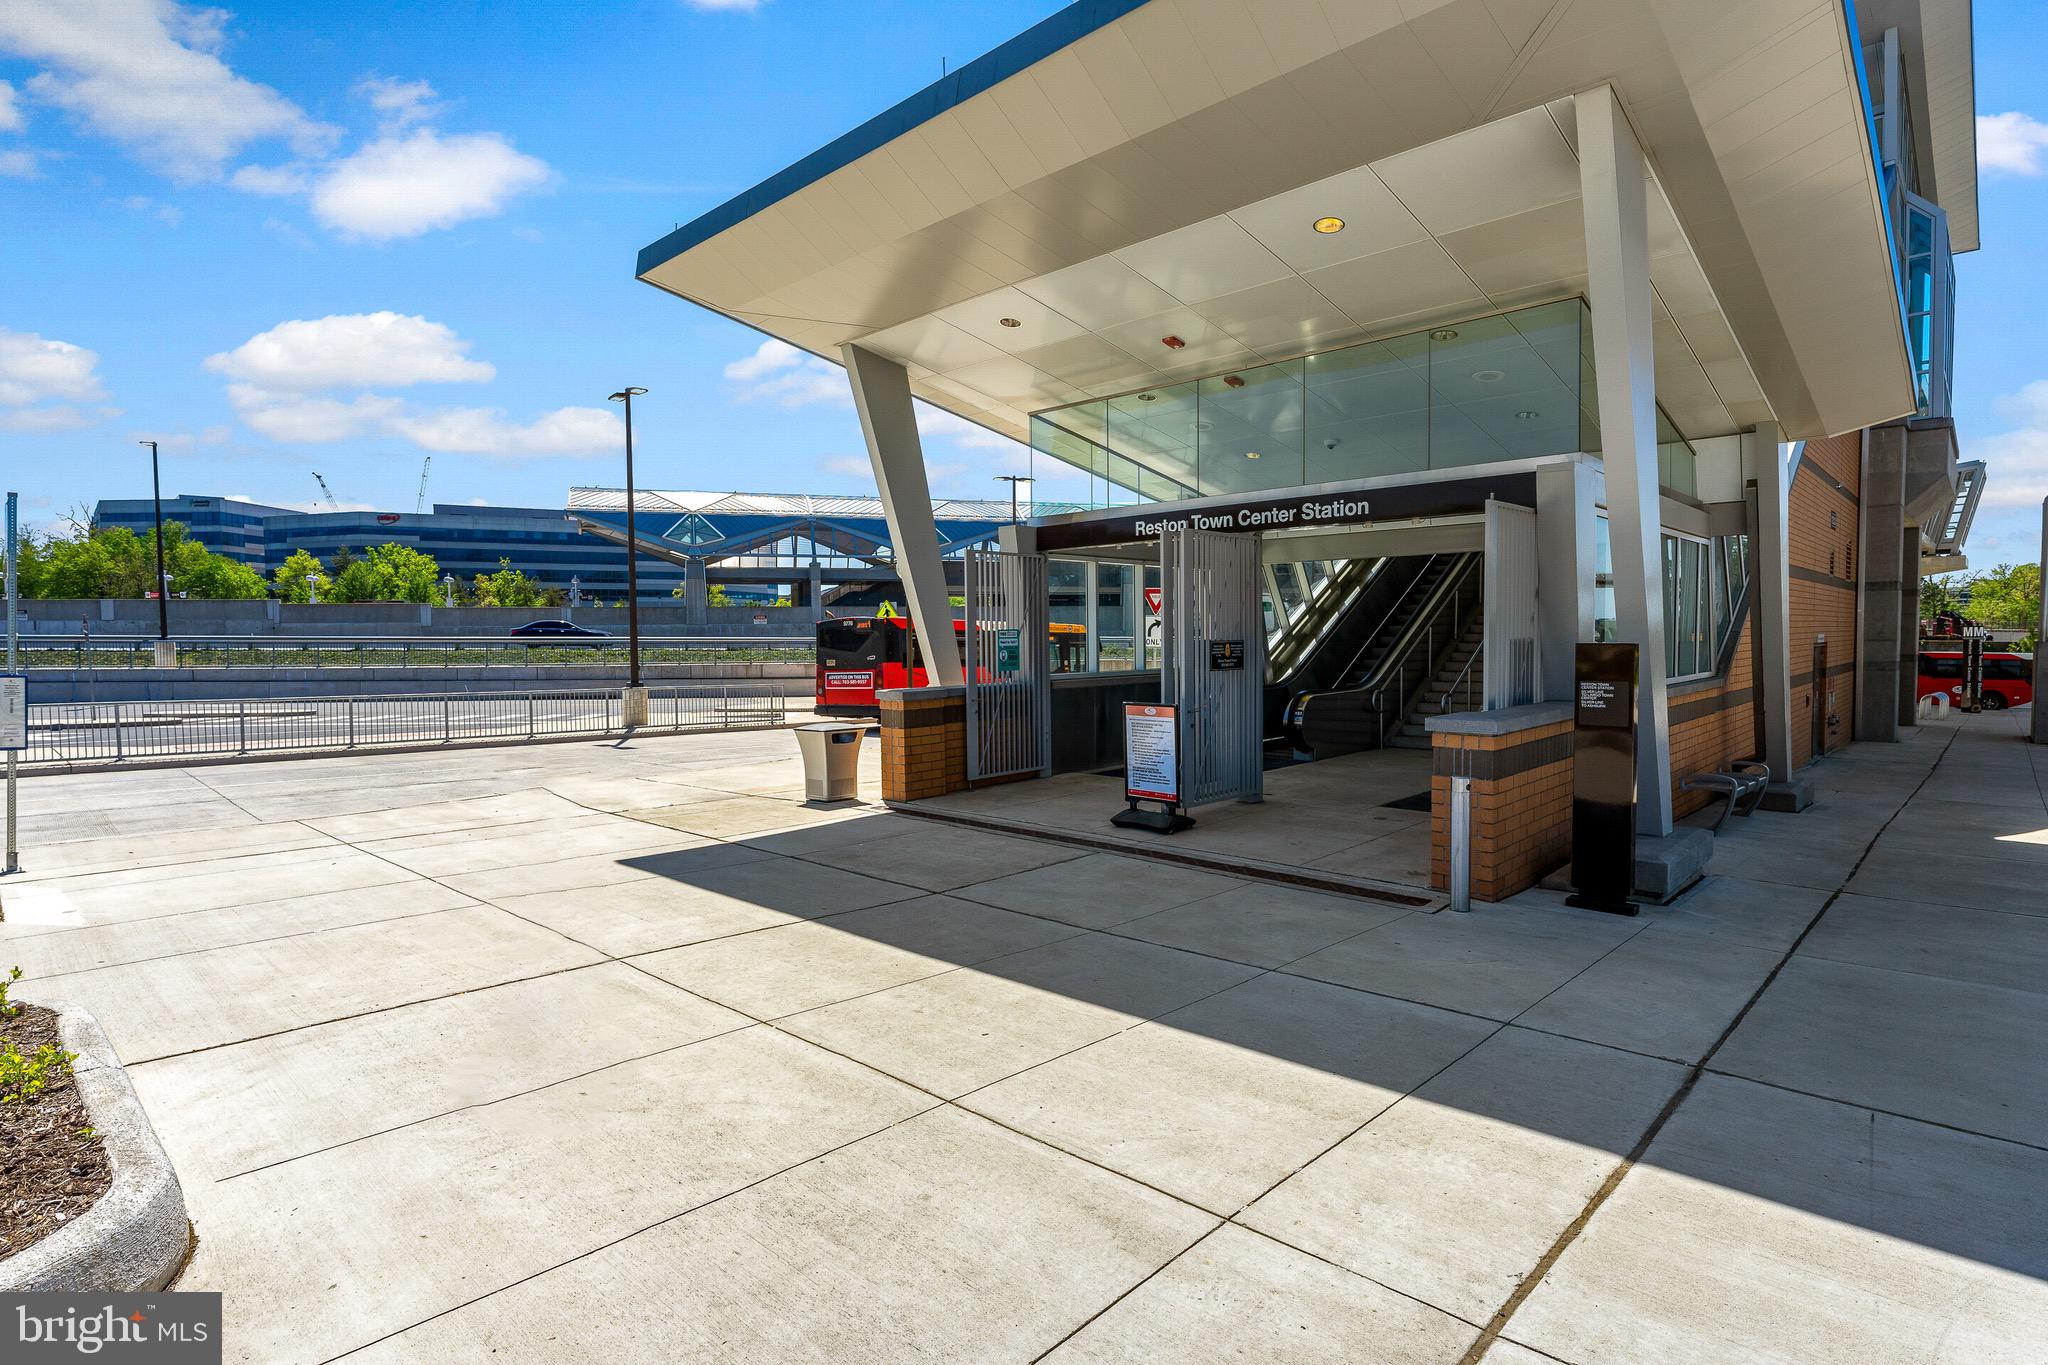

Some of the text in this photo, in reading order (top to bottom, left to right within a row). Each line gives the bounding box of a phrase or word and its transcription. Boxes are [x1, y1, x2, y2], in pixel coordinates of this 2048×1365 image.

[1135, 499, 1369, 536] Reston Town Center Station
[1145, 638, 1162, 646] ONL
